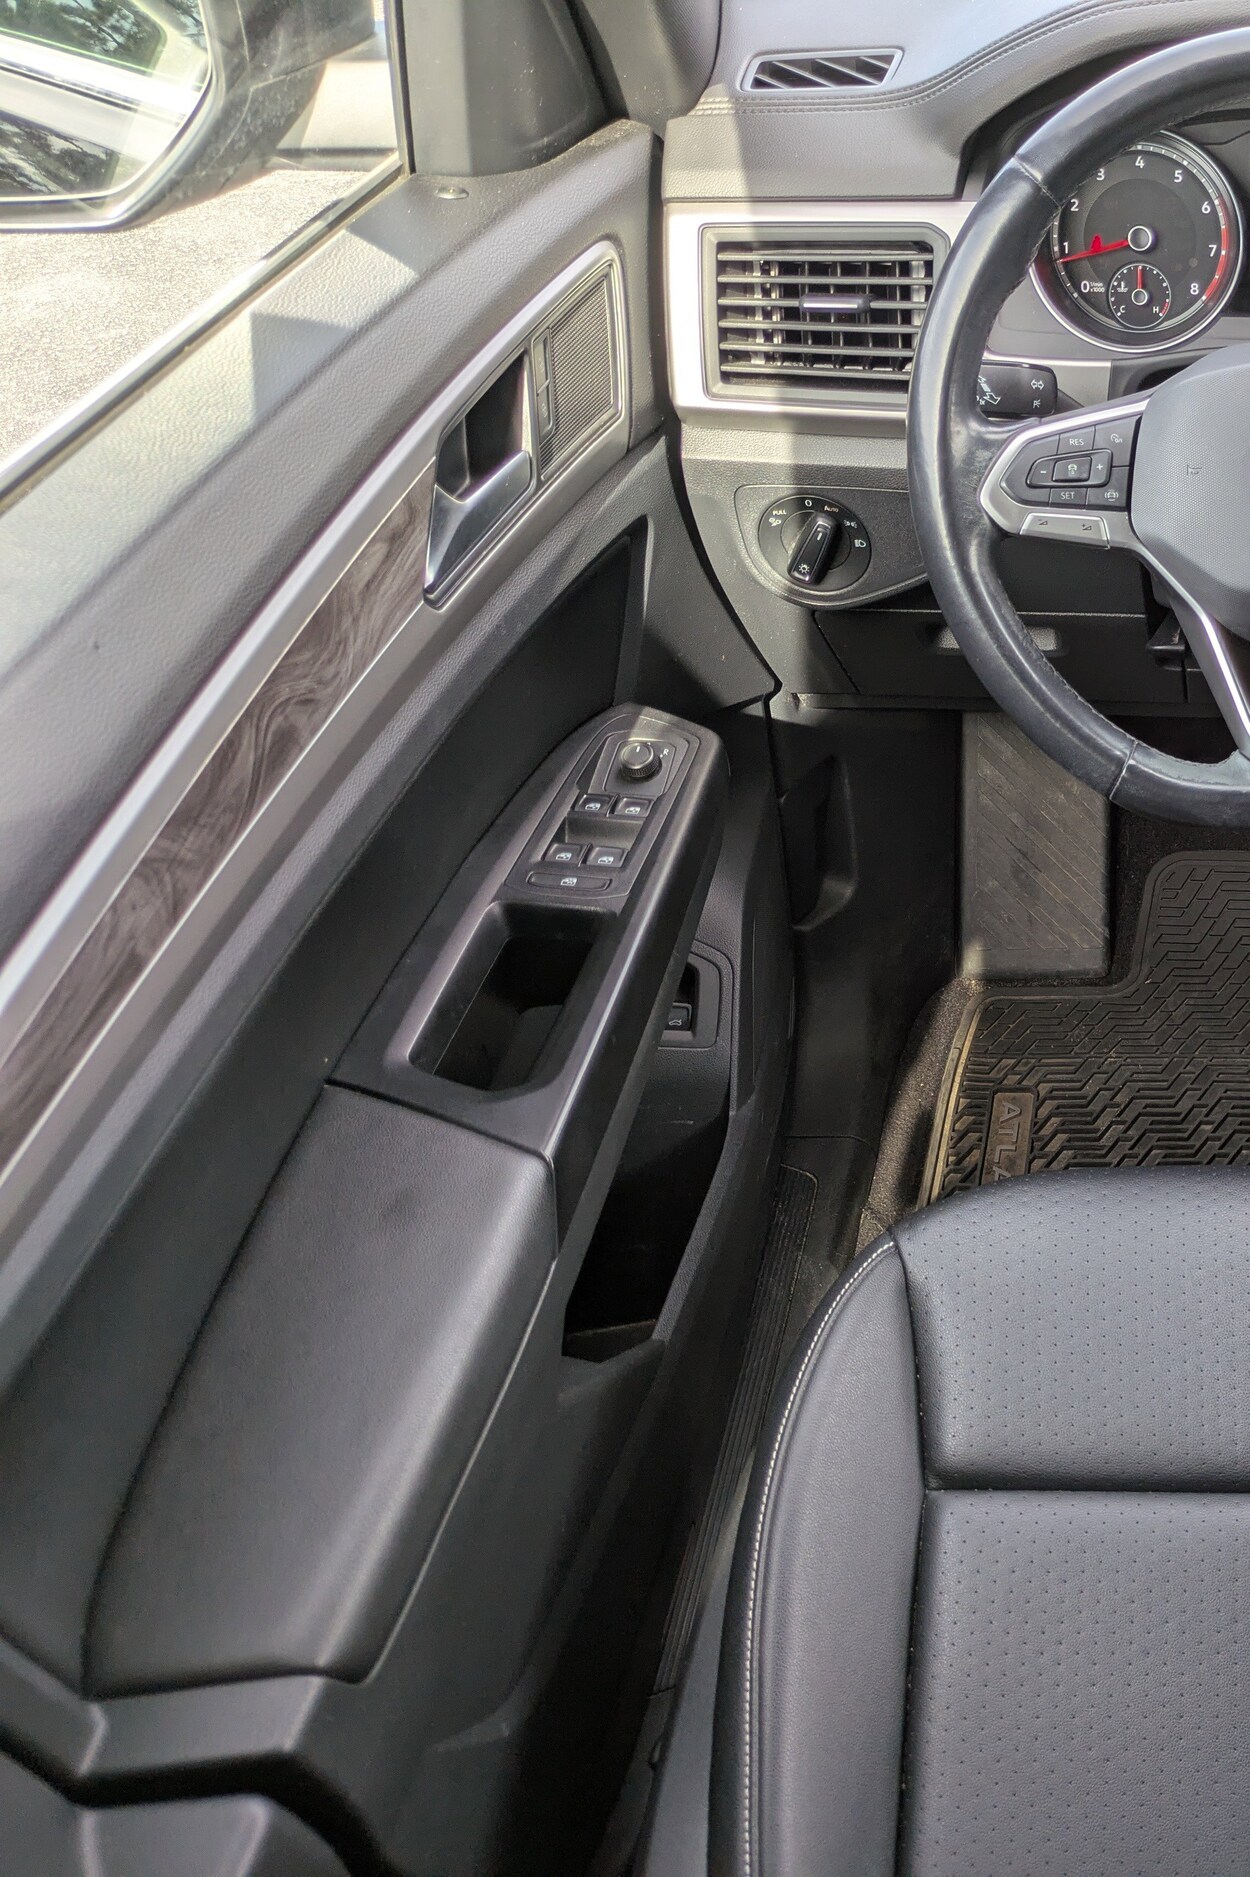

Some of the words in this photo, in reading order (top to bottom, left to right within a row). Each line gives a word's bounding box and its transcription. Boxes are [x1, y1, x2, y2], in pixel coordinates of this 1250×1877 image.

[1135, 156, 1145, 169] 4
[1096, 168, 1105, 181] 3
[1174, 170, 1183, 183] 5
[1070, 199, 1079, 212] 2
[1201, 201, 1211, 214] 6
[1063, 241, 1069, 254] 1
[1209, 245, 1217, 257] 7
[1080, 280, 1090, 293] 0
[1190, 283, 1199, 295] 8
[1119, 305, 1126, 314] C
[1152, 306, 1159, 314] H
[1069, 438, 1085, 446] RES
[1060, 491, 1075, 500] SET
